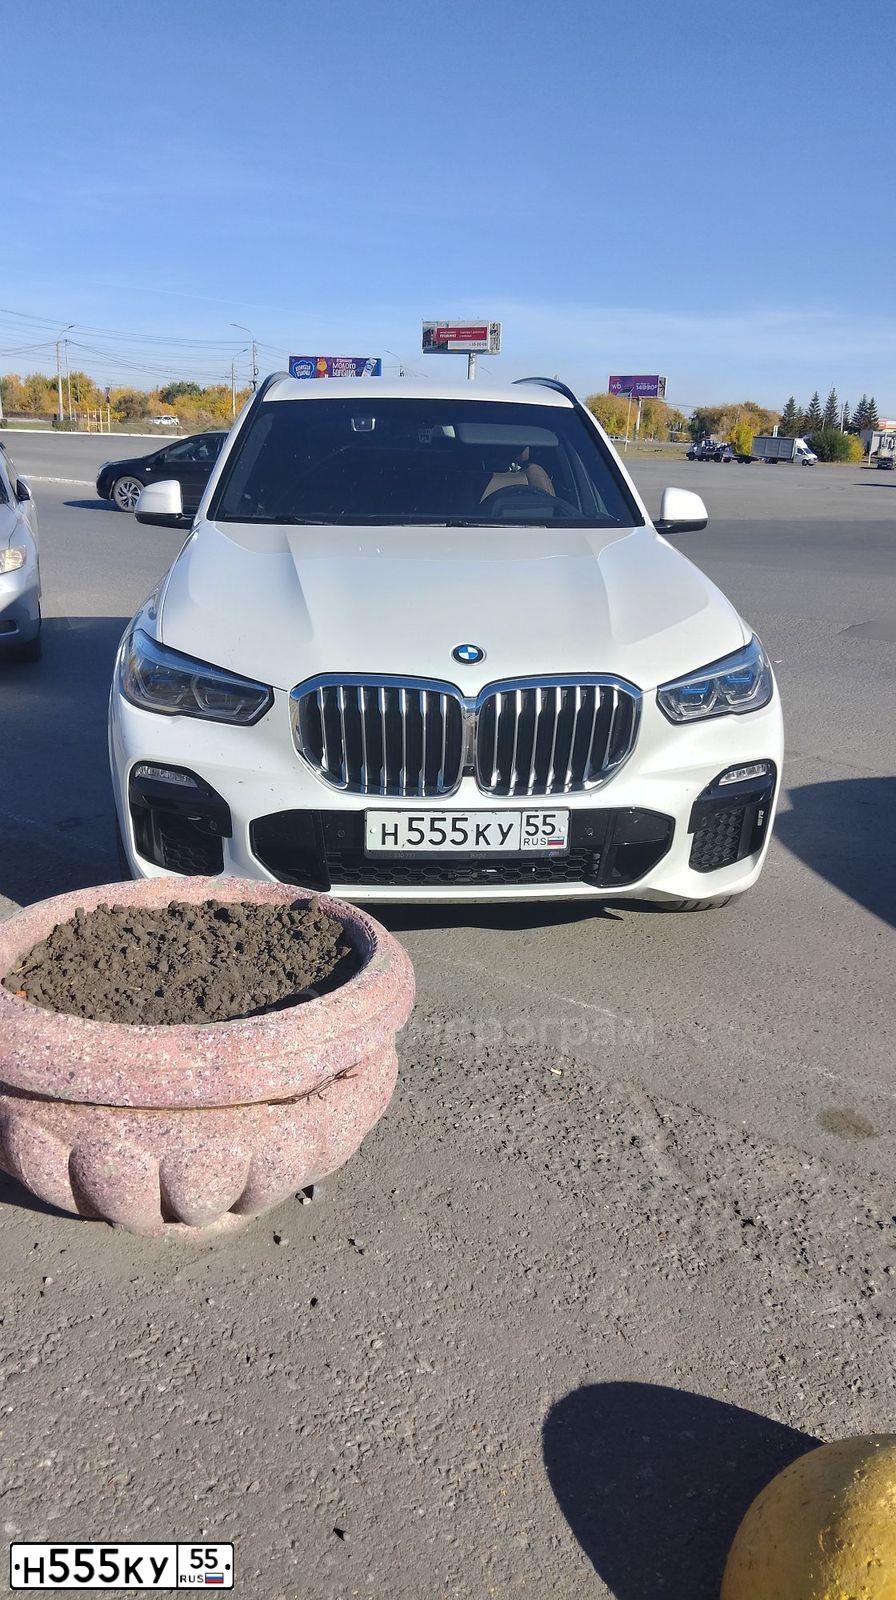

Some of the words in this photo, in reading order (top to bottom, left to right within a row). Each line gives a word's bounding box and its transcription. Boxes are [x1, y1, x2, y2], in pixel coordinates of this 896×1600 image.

[381, 816, 515, 846] Н555КУ
[524, 814, 557, 837] 55
[523, 838, 547, 846] RUS
